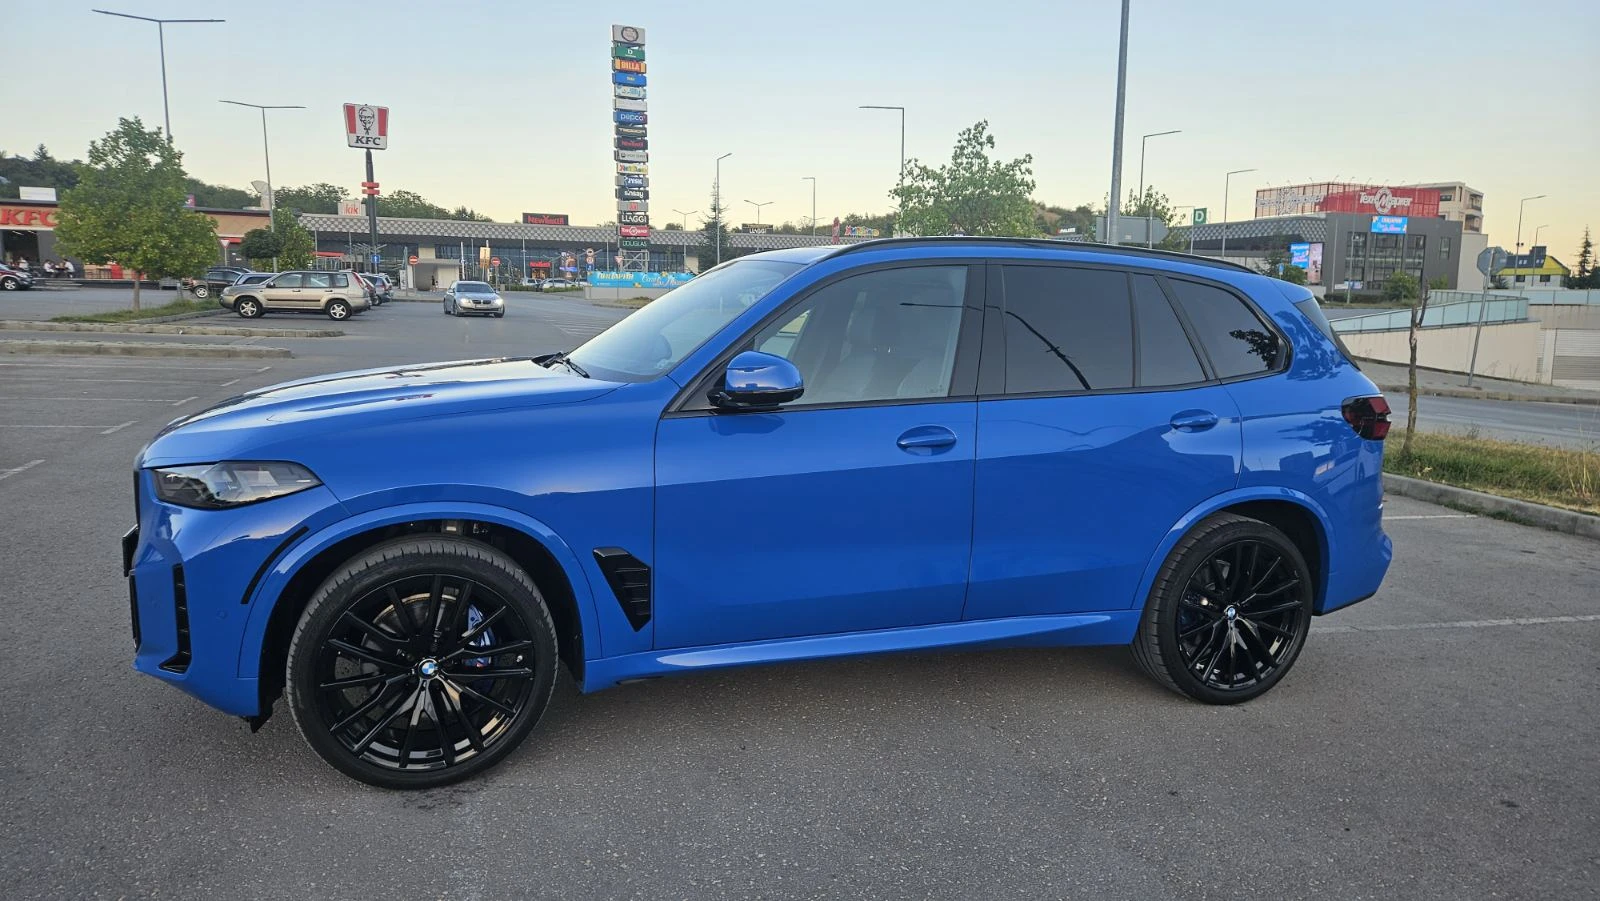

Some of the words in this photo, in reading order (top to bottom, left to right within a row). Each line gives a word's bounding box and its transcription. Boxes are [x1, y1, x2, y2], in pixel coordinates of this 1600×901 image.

[621, 61, 640, 70] BILLA
[355, 135, 381, 146] KFC
[1, 208, 58, 227] KFC
[1195, 210, 1204, 221] D
